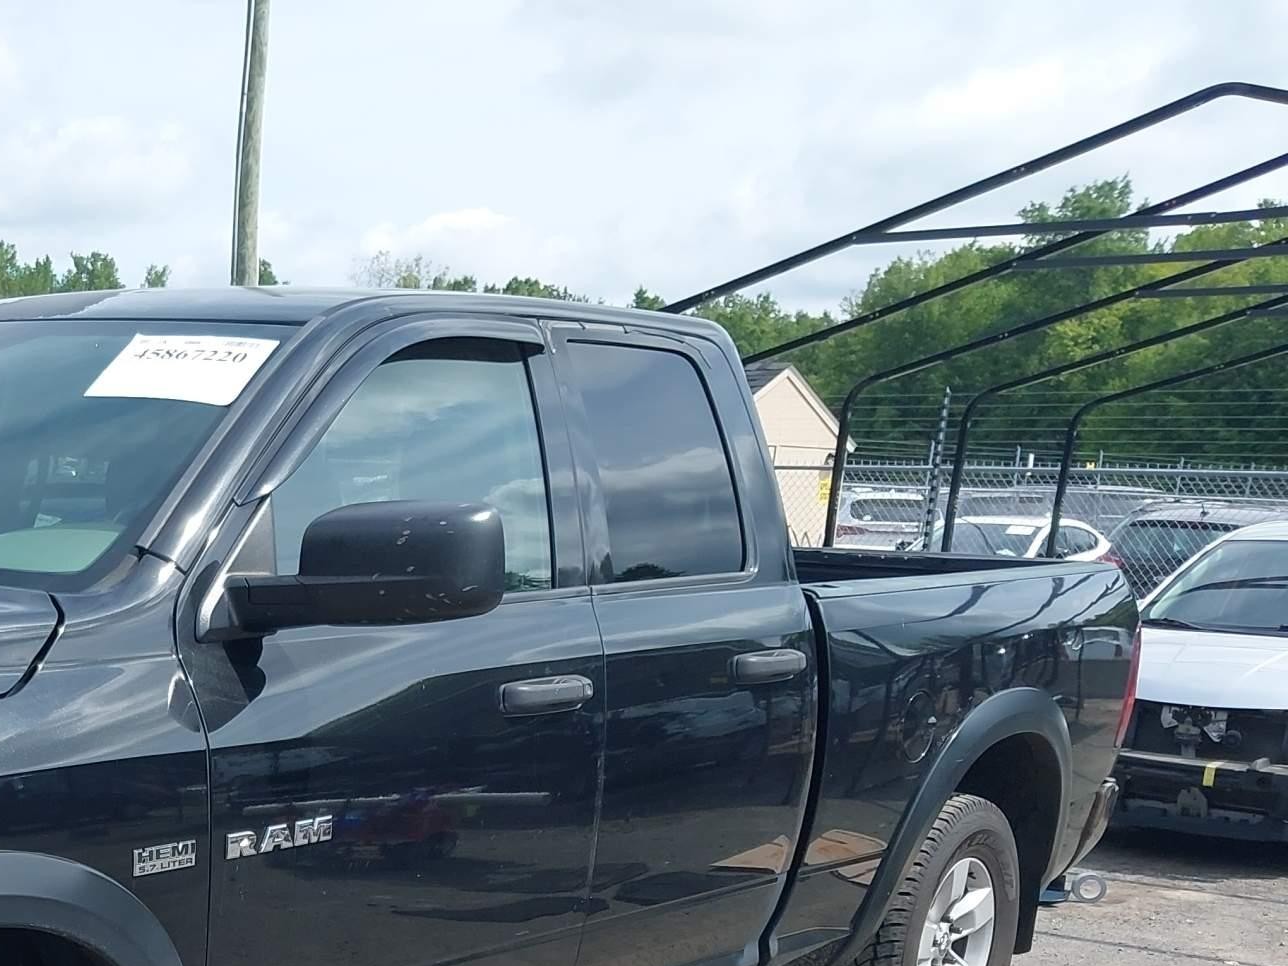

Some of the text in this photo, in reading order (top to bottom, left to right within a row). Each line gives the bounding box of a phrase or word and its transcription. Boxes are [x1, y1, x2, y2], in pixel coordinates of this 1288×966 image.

[133, 347, 249, 364] 45867220
[225, 815, 333, 860] RAM
[137, 842, 196, 864] HEMI
[138, 856, 194, 874] 5.7 LITER
